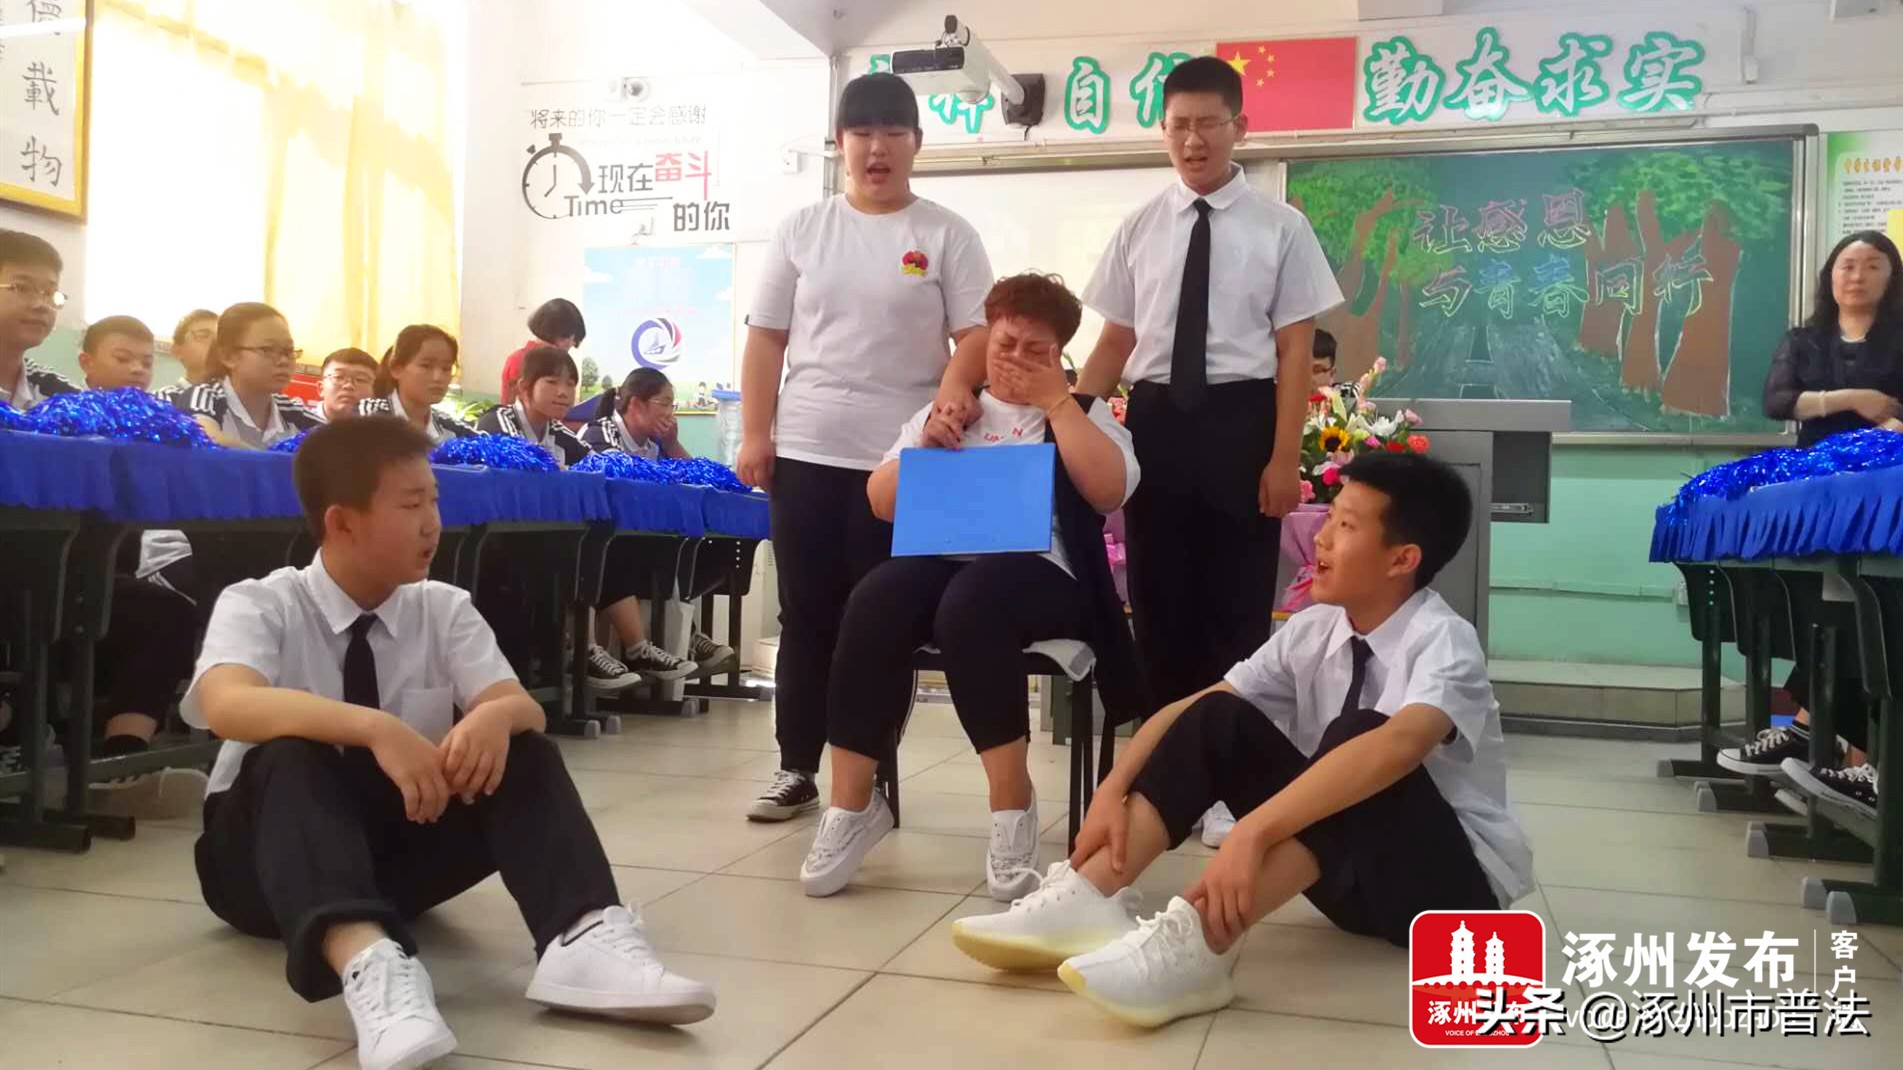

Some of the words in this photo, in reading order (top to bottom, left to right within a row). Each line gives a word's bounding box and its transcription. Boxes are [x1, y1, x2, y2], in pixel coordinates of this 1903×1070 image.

[1363, 27, 1705, 124] 勤奋求实
[529, 104, 707, 128] 将来的你一定会感谢
[564, 195, 623, 217] Time
[673, 201, 730, 231] 的你
[1413, 188, 1591, 255] 让感恩
